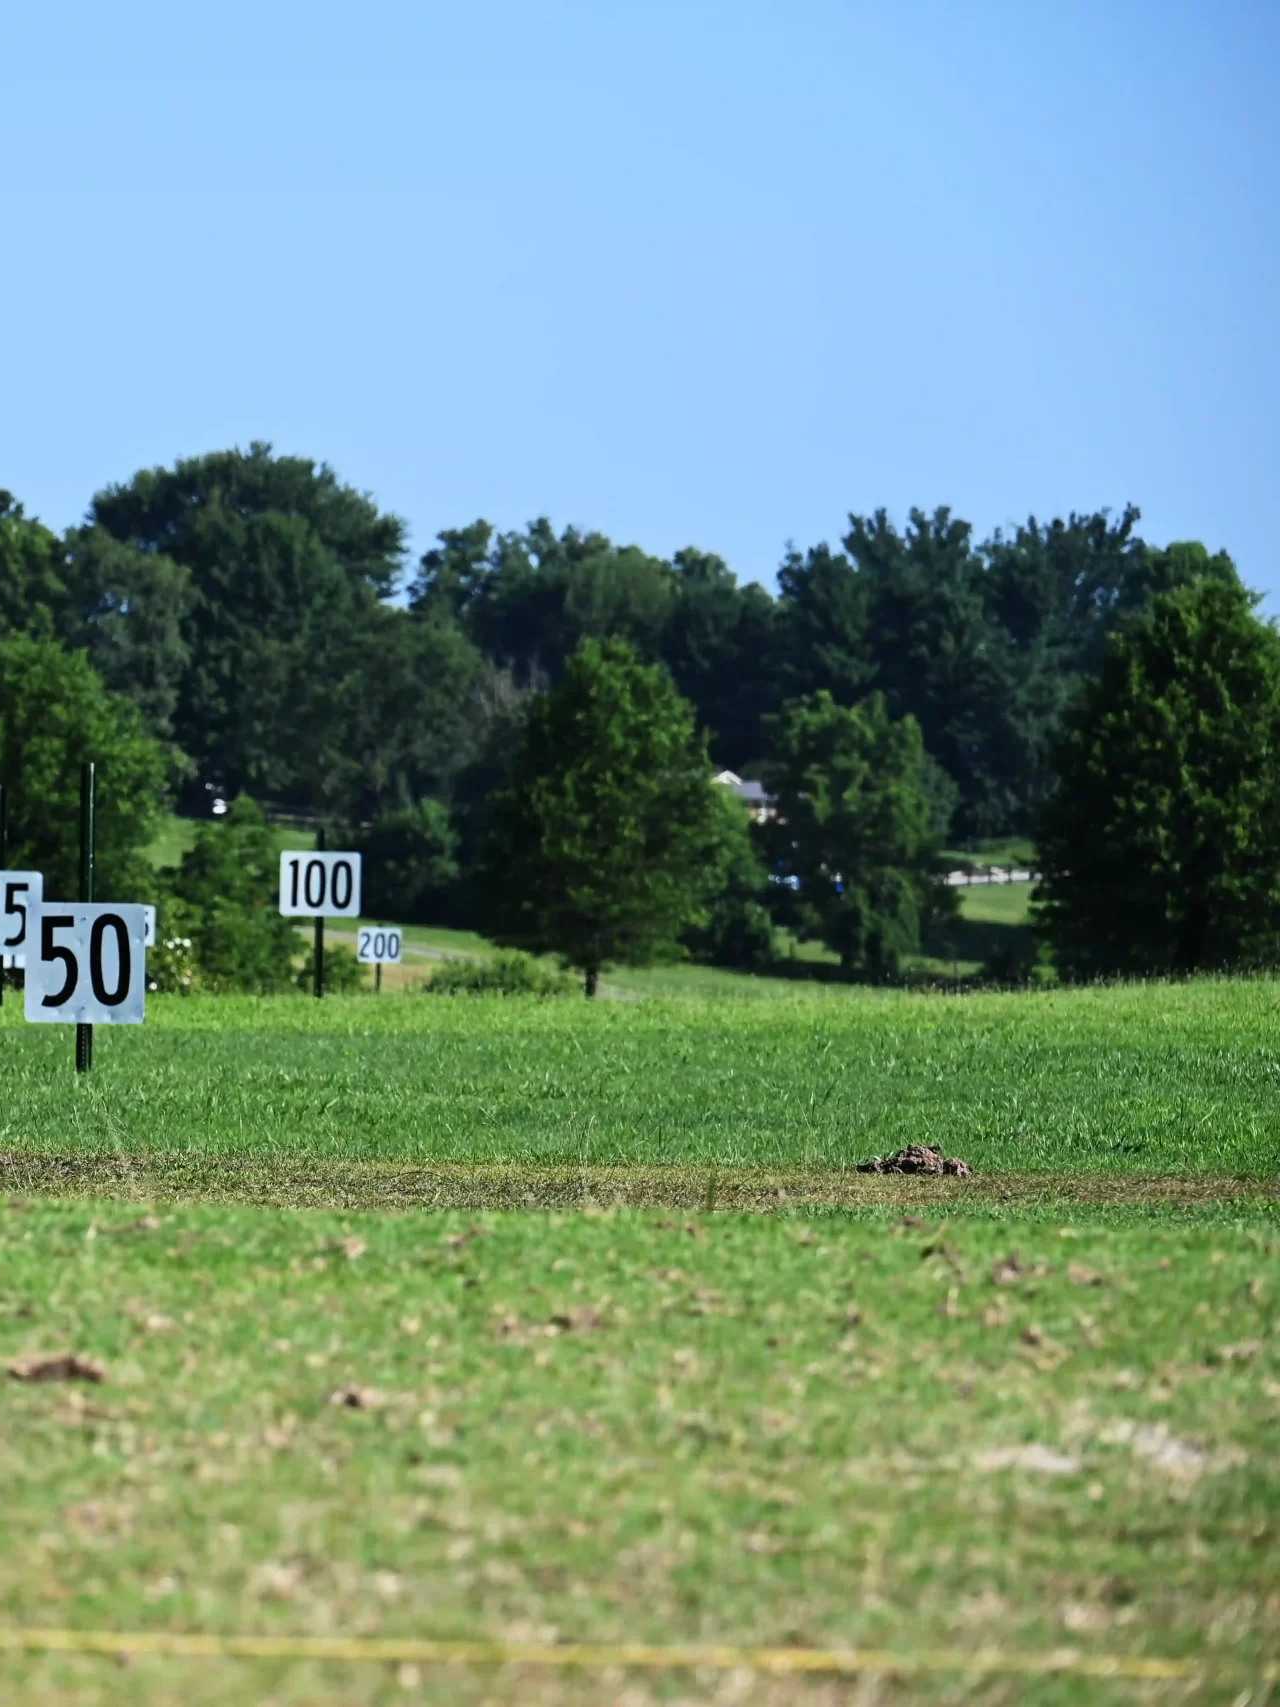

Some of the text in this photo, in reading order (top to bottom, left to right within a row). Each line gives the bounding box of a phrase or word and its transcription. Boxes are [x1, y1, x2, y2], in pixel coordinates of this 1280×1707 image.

[288, 859, 353, 910] 100
[40, 912, 132, 1008] 50
[359, 933, 399, 959] 200
